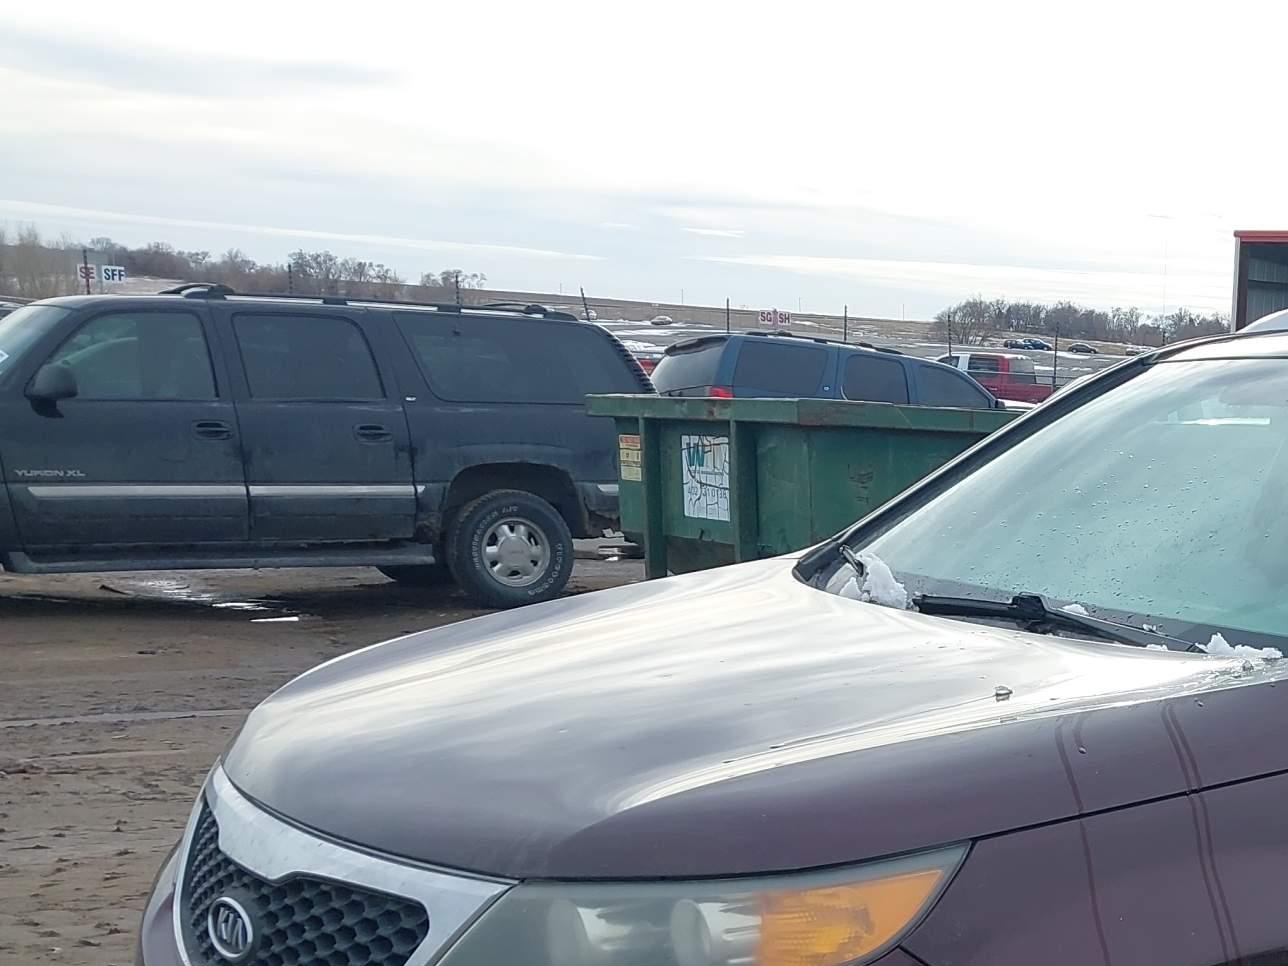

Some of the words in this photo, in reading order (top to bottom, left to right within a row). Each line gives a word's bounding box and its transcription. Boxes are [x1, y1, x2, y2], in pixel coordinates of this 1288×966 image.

[103, 268, 125, 281] SFF
[760, 311, 772, 322] SG
[778, 313, 790, 324] SH
[14, 469, 64, 477] YUKON
[65, 469, 86, 477] XL
[215, 904, 247, 952] KIA
